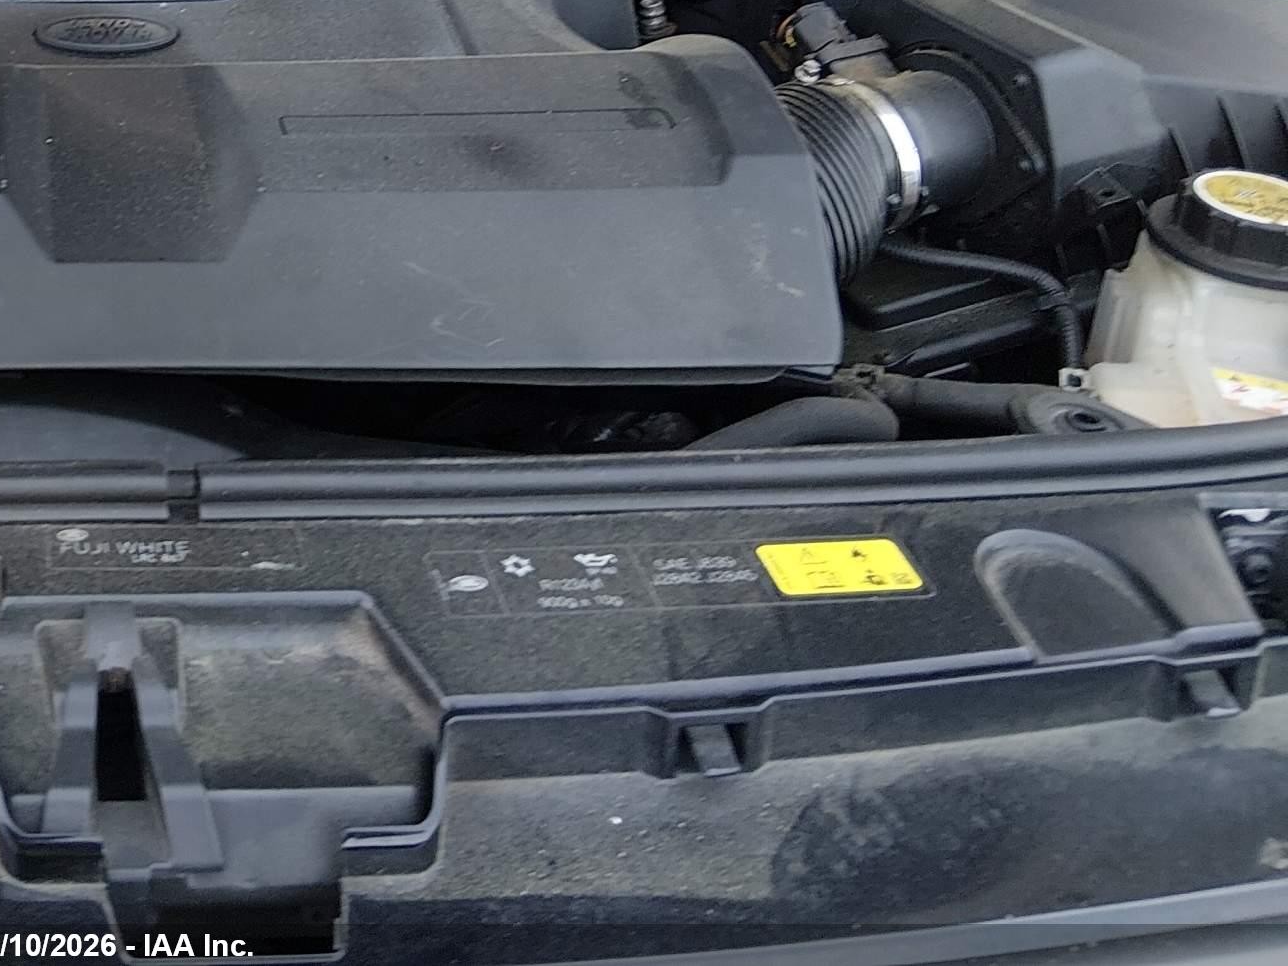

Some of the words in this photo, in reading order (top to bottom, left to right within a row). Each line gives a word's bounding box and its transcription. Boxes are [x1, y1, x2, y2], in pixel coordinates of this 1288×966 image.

[59, 542, 110, 555] FUJI
[115, 540, 192, 554] WHITE
[653, 558, 693, 570] SAE
